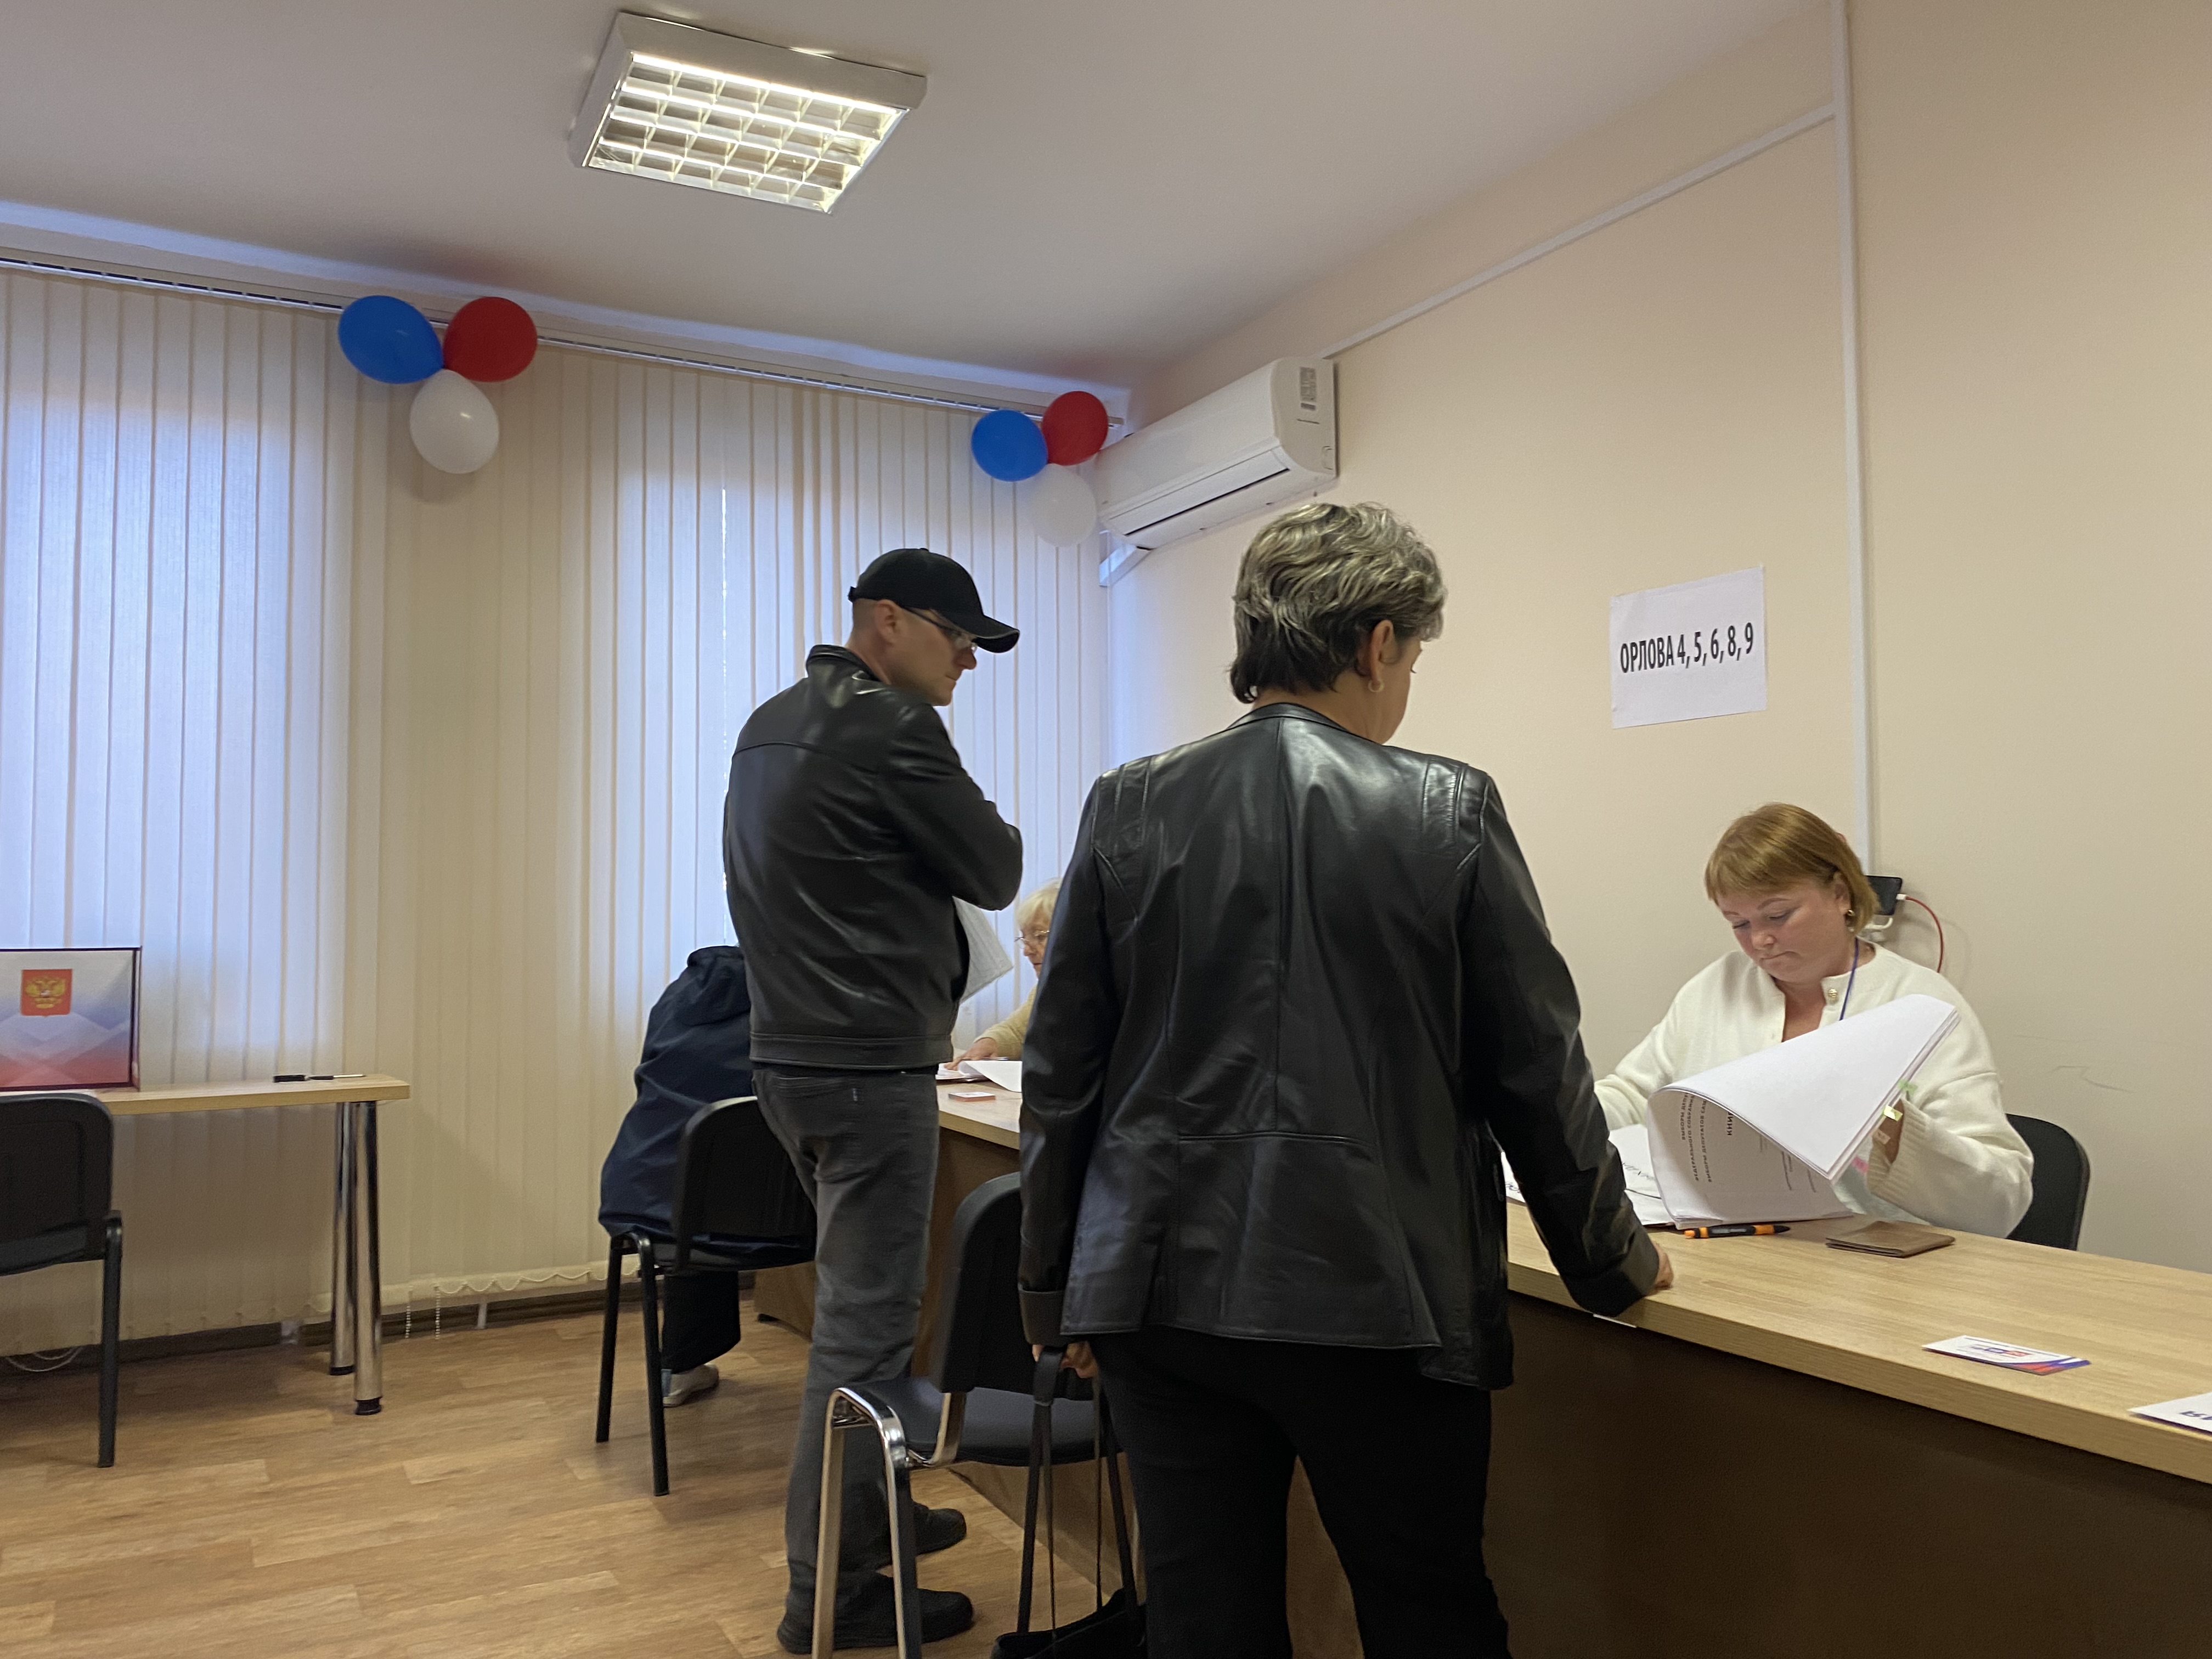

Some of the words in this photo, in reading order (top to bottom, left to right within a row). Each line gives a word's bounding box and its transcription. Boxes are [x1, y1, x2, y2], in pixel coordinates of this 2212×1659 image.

[1620, 635, 1674, 673] ОРЛОВА
[1677, 634, 1690, 669] 4,
[1694, 631, 1707, 666] 5,
[1711, 628, 1724, 663] 6,
[1728, 625, 1741, 661] 8,
[1745, 622, 1753, 654] 9
[1688, 1130, 1699, 1181] ФЕДЕРАЛЬНОГО
[1703, 1155, 1712, 1183] ВЫБОРЫ
